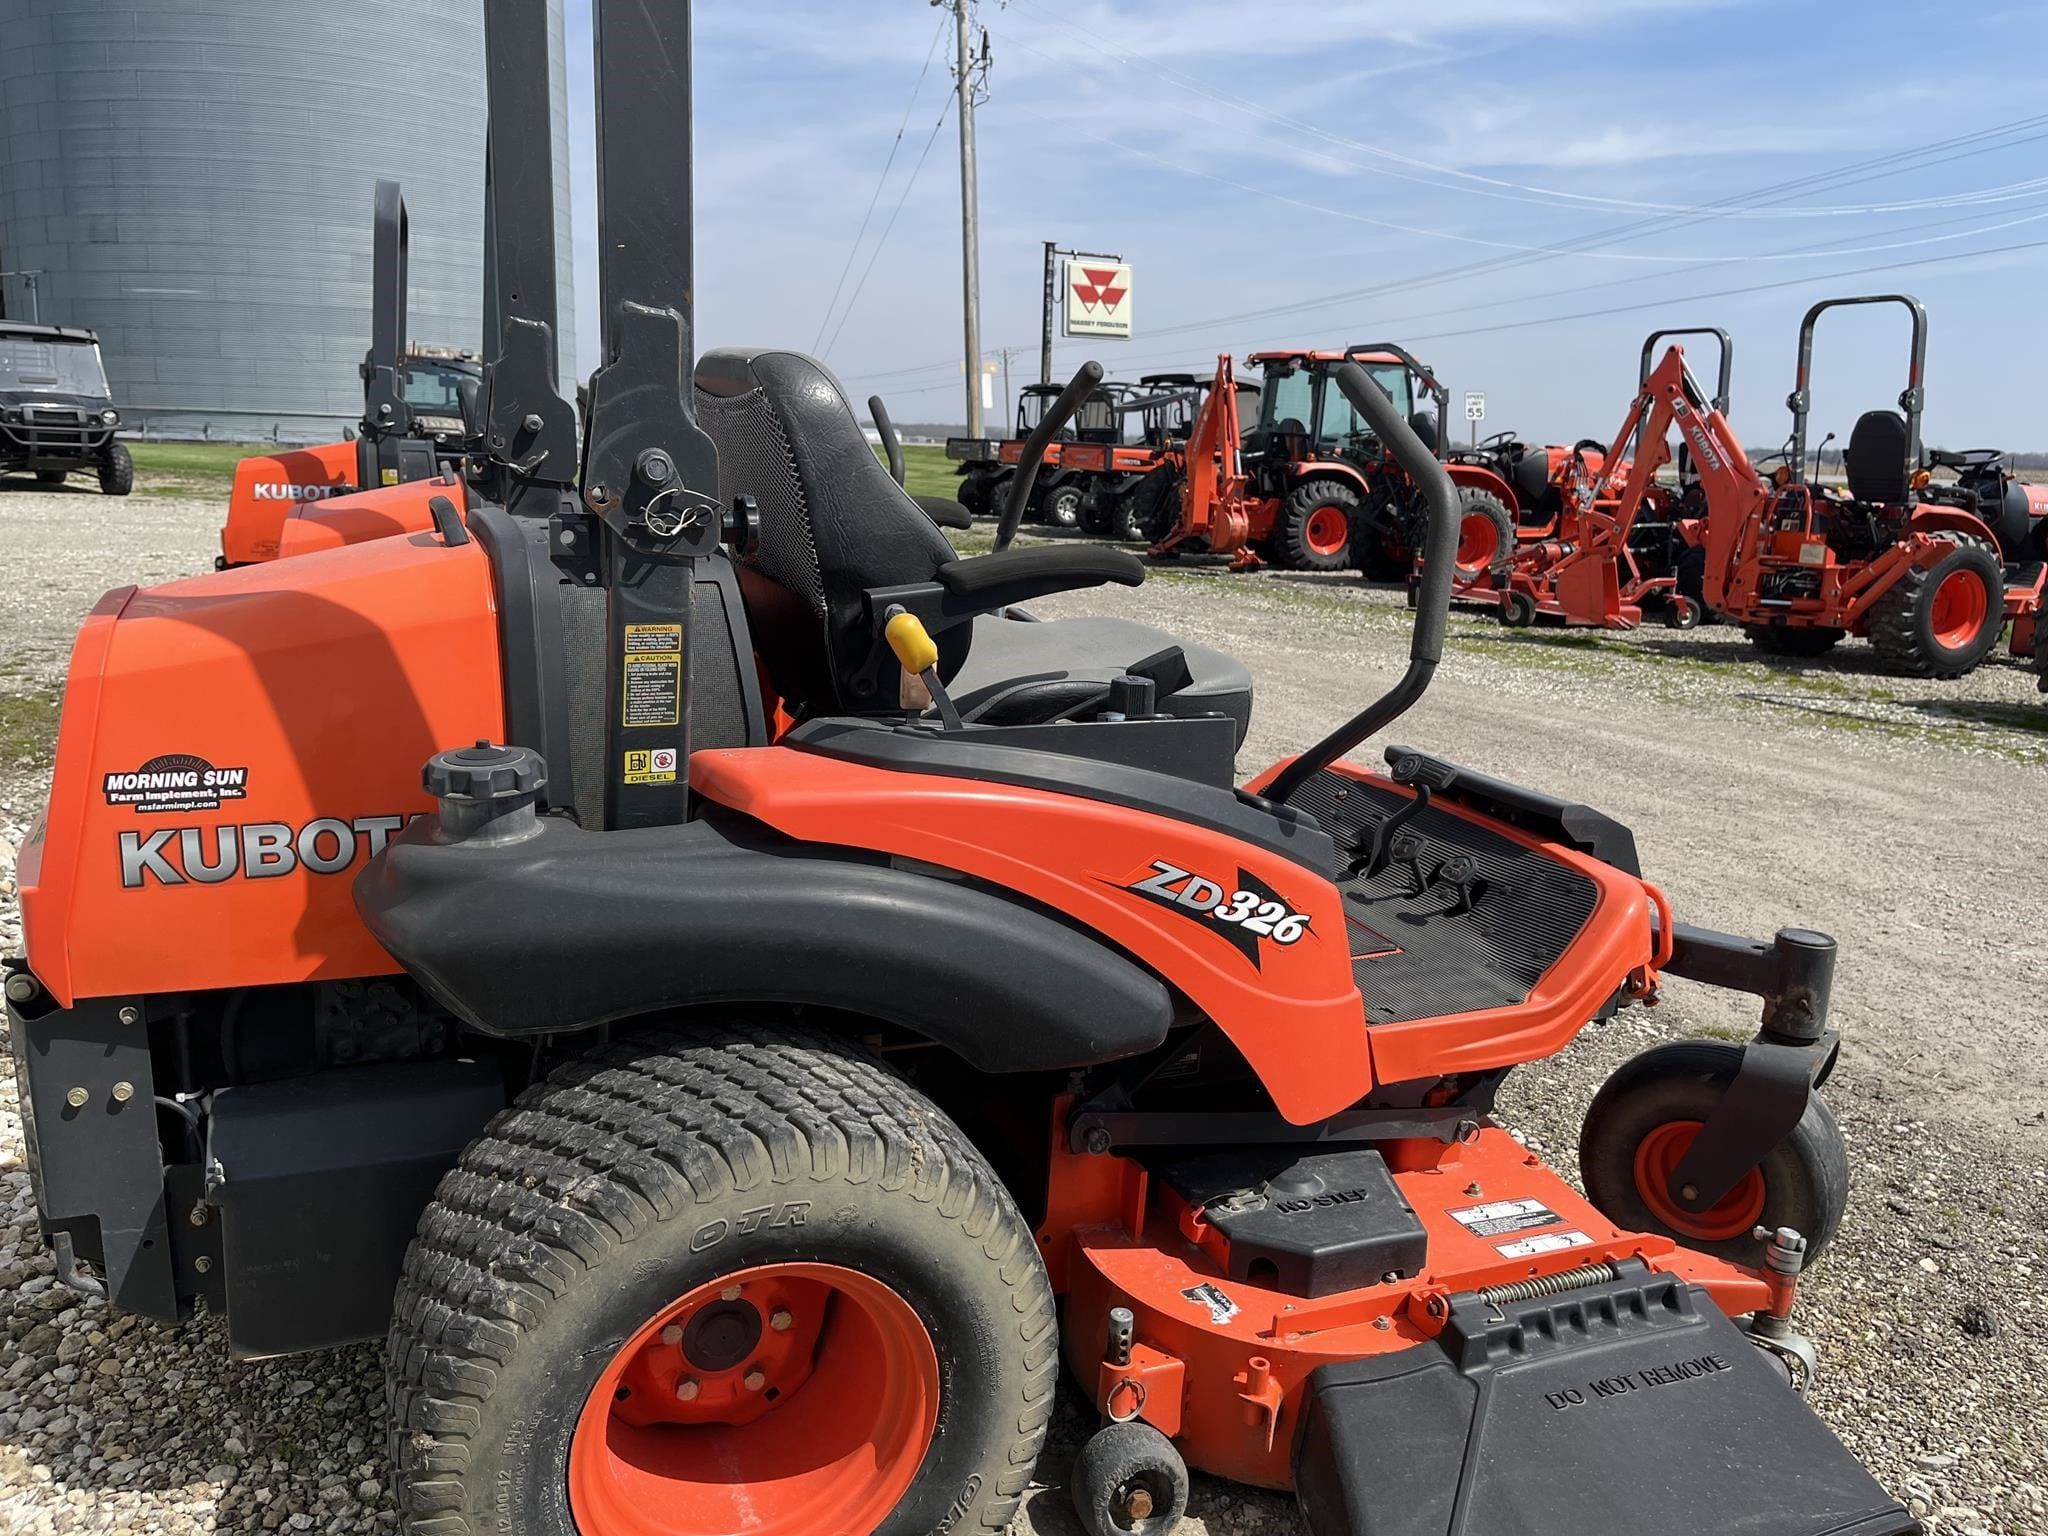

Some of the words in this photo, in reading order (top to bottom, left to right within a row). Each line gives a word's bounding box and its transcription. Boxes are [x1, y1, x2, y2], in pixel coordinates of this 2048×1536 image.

[1467, 407, 1483, 418] 55
[1689, 424, 1720, 471] KUBOTA
[254, 483, 331, 500] KUBOT
[106, 771, 199, 791] MORNING
[203, 769, 243, 786] SUN
[630, 773, 671, 782] DIESEL
[110, 791, 145, 802] Farm
[145, 788, 218, 802] Implement,
[219, 787, 242, 797] Inc.
[137, 800, 218, 811] msfarmimpl.com
[118, 813, 428, 887] KUBOT
[1130, 859, 1311, 944] ZD326
[1275, 1200, 1312, 1214] NO
[1312, 1189, 1369, 1208] STEP
[689, 1200, 813, 1254] OTR
[1544, 1387, 1586, 1410] DO
[1588, 1374, 1638, 1399] NOT
[1637, 1352, 1733, 1387] REMOVE
